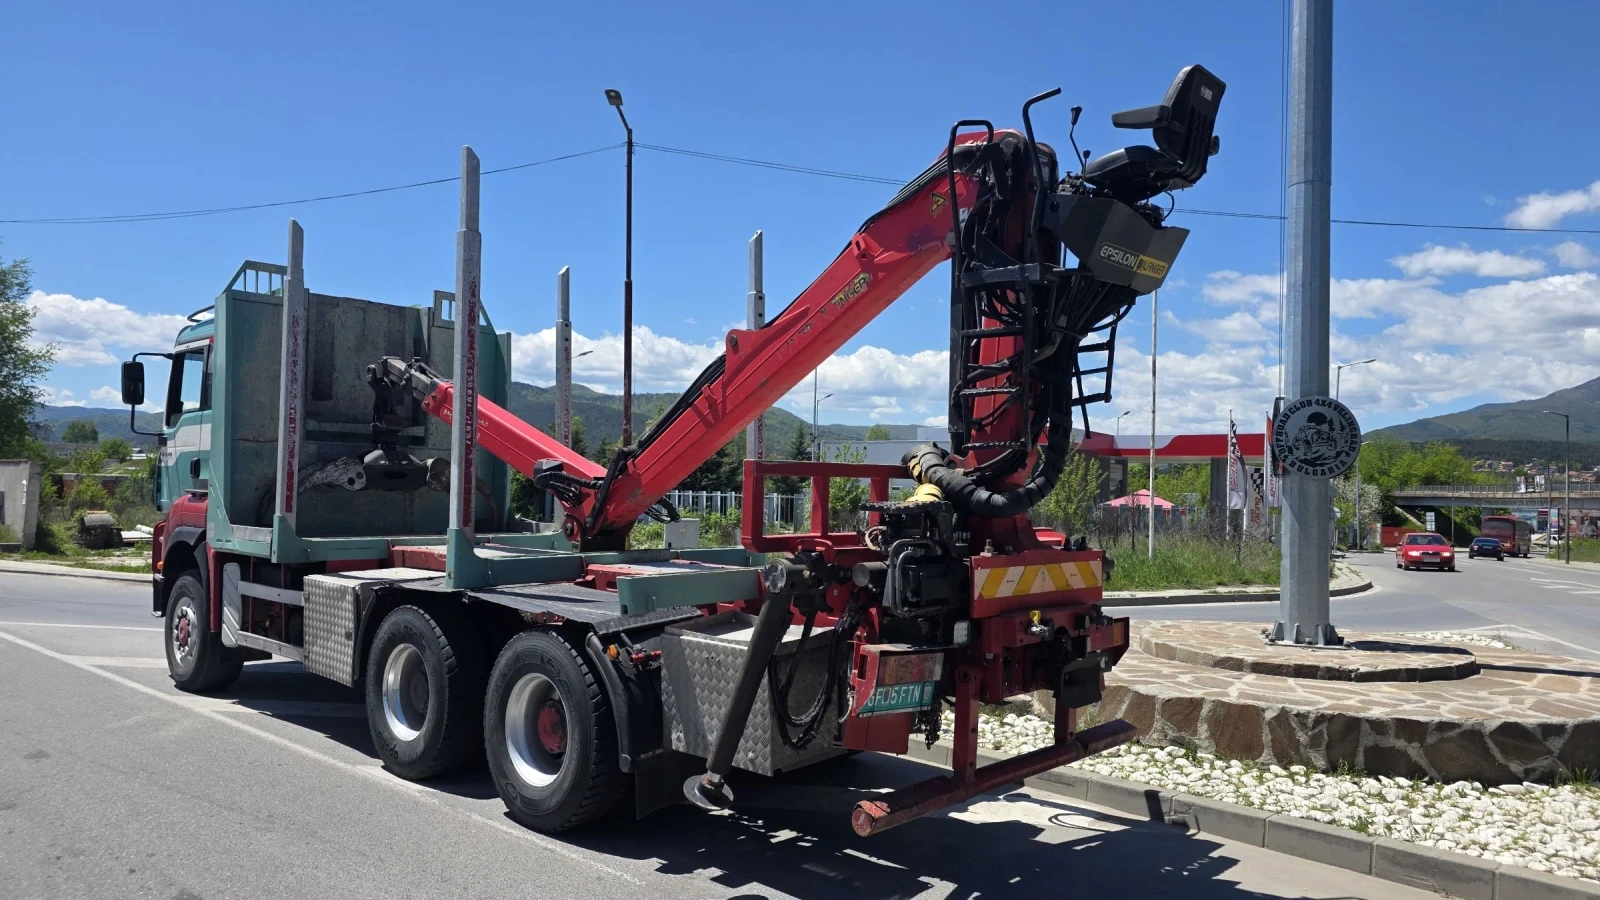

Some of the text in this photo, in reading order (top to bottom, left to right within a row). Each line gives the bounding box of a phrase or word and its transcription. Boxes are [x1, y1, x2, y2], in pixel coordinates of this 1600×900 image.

[1100, 245, 1138, 267] EPSILON
[1276, 399, 1358, 453] OFFROAD CLUB 4X4 VELINGRAD
[1289, 459, 1348, 477] BULGARIA
